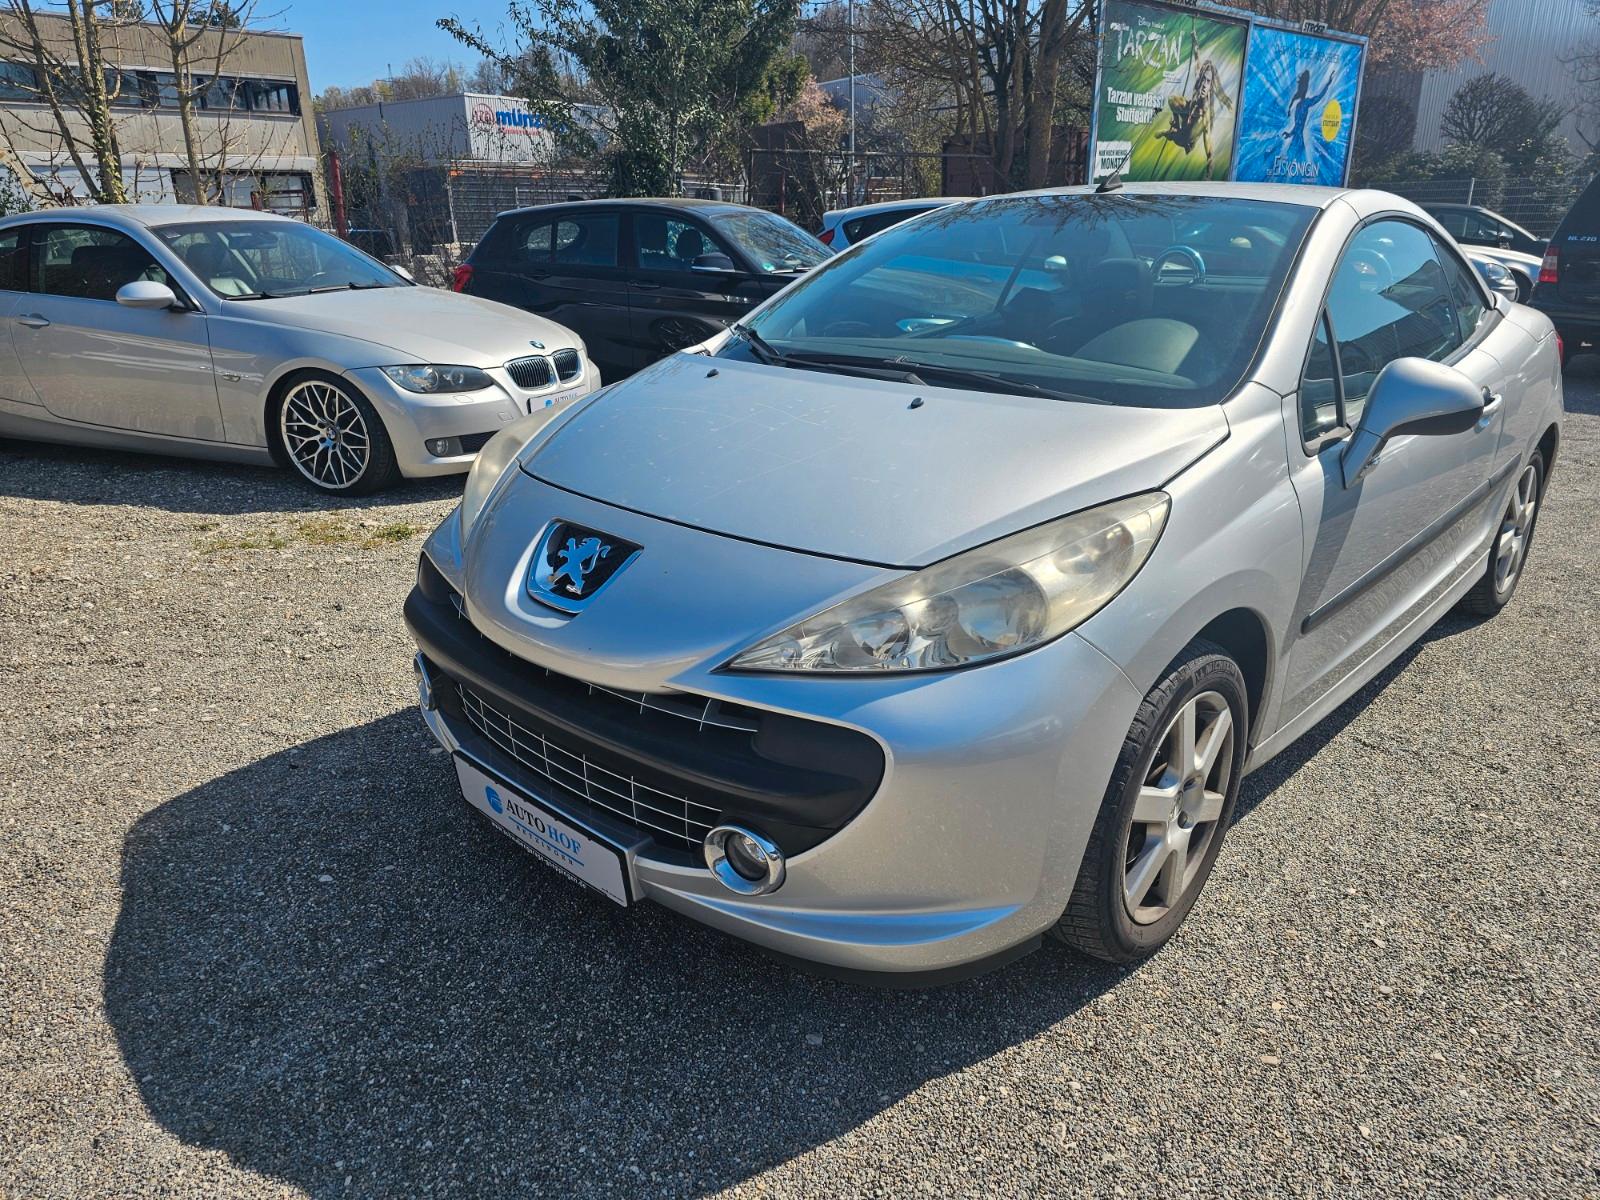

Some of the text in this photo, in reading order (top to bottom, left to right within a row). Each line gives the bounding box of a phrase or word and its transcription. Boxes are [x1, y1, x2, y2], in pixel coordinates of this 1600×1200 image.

[1110, 22, 1185, 69] TARZAN
[1107, 86, 1165, 110] Tarzan verlässt
[1116, 106, 1154, 125] Stuttgart!
[506, 799, 581, 854] AUTO HOF
